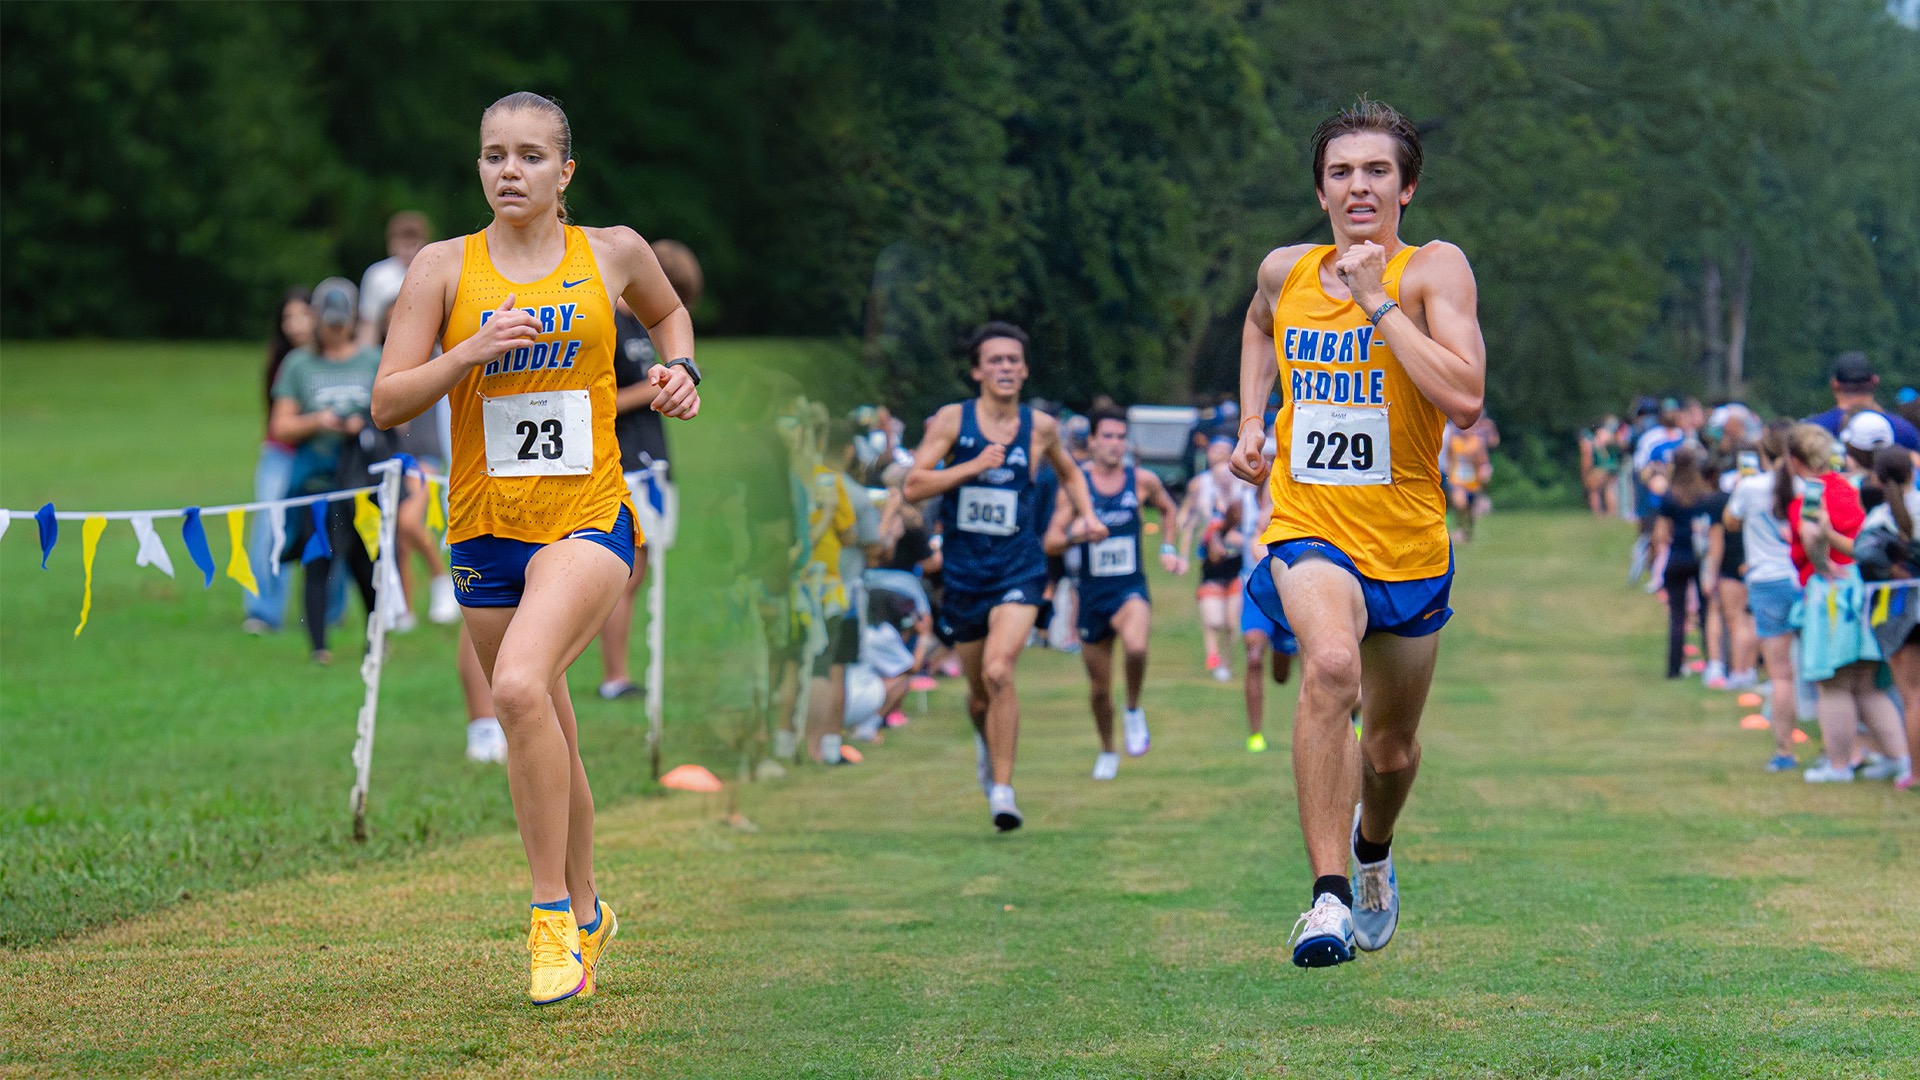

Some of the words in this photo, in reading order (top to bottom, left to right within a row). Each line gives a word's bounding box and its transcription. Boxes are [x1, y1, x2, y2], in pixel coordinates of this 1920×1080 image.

[480, 302, 586, 334] RY-
[1284, 325, 1385, 363] EMBRY-
[1291, 368, 1385, 404] RIDDLE
[516, 418, 564, 460] 23
[1306, 430, 1373, 470] 229
[967, 501, 1006, 524] 303
